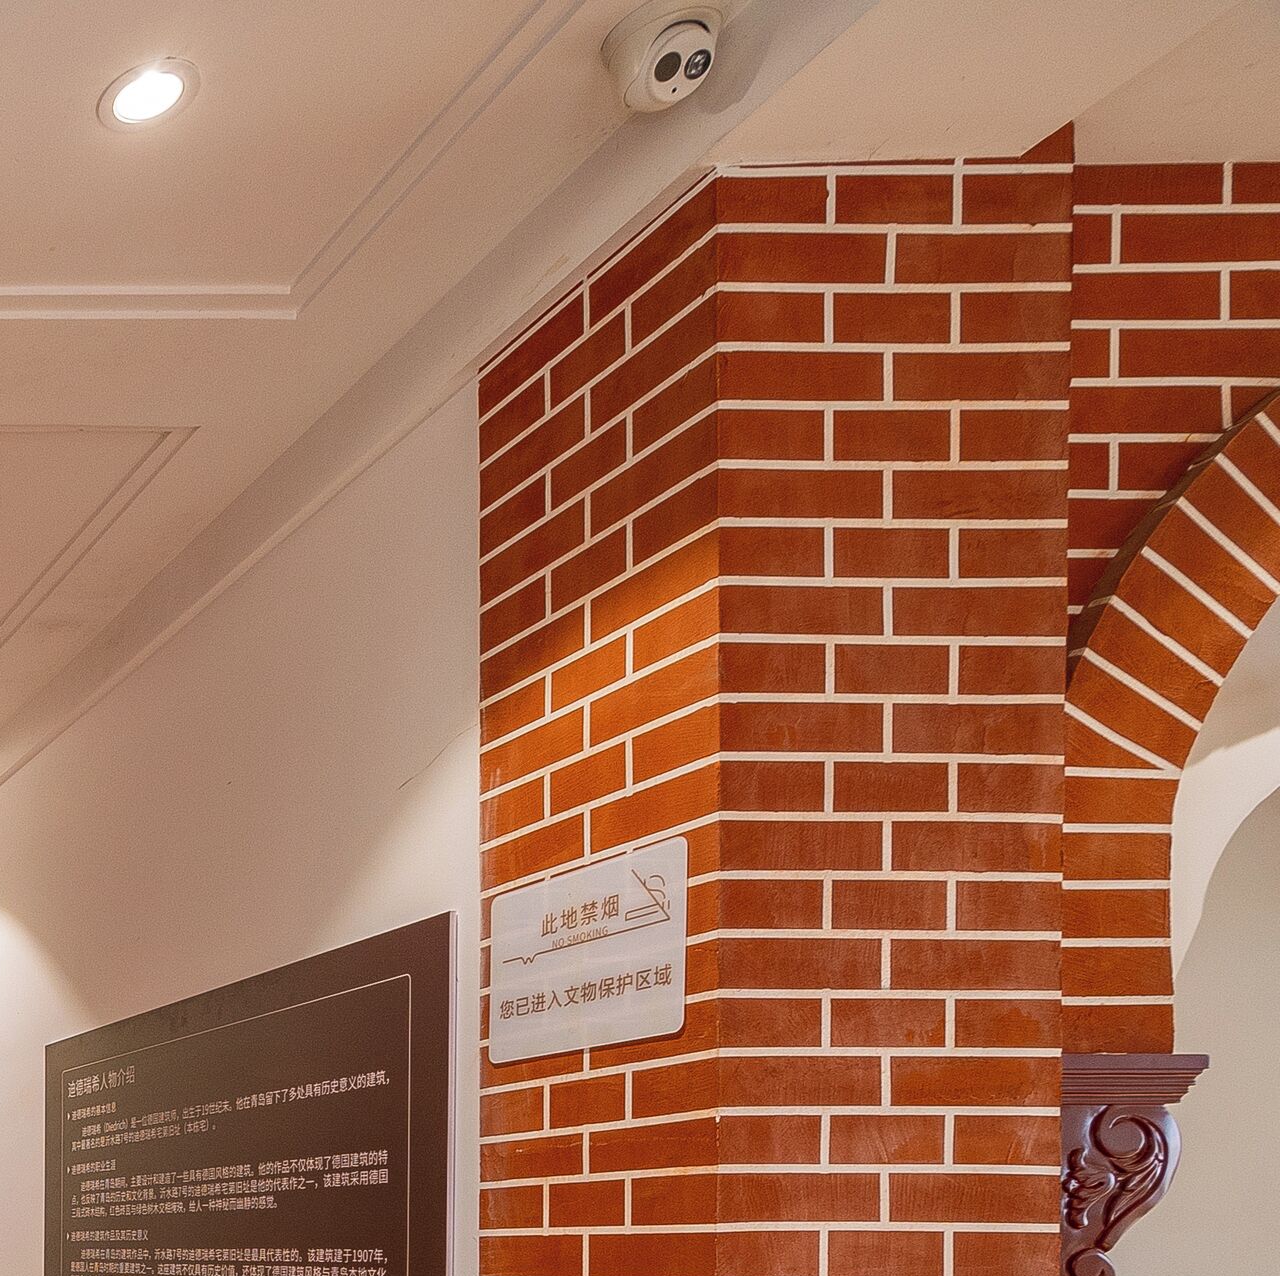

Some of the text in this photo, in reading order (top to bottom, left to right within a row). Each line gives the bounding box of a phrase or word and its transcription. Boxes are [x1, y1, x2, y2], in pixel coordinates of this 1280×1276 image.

[541, 894, 619, 937] 此地禁烟
[552, 926, 609, 948] NO SMOKING
[499, 963, 672, 1020] 您已进入文物保护区域
[67, 1065, 134, 1099] 迪德瑞希人物介绍
